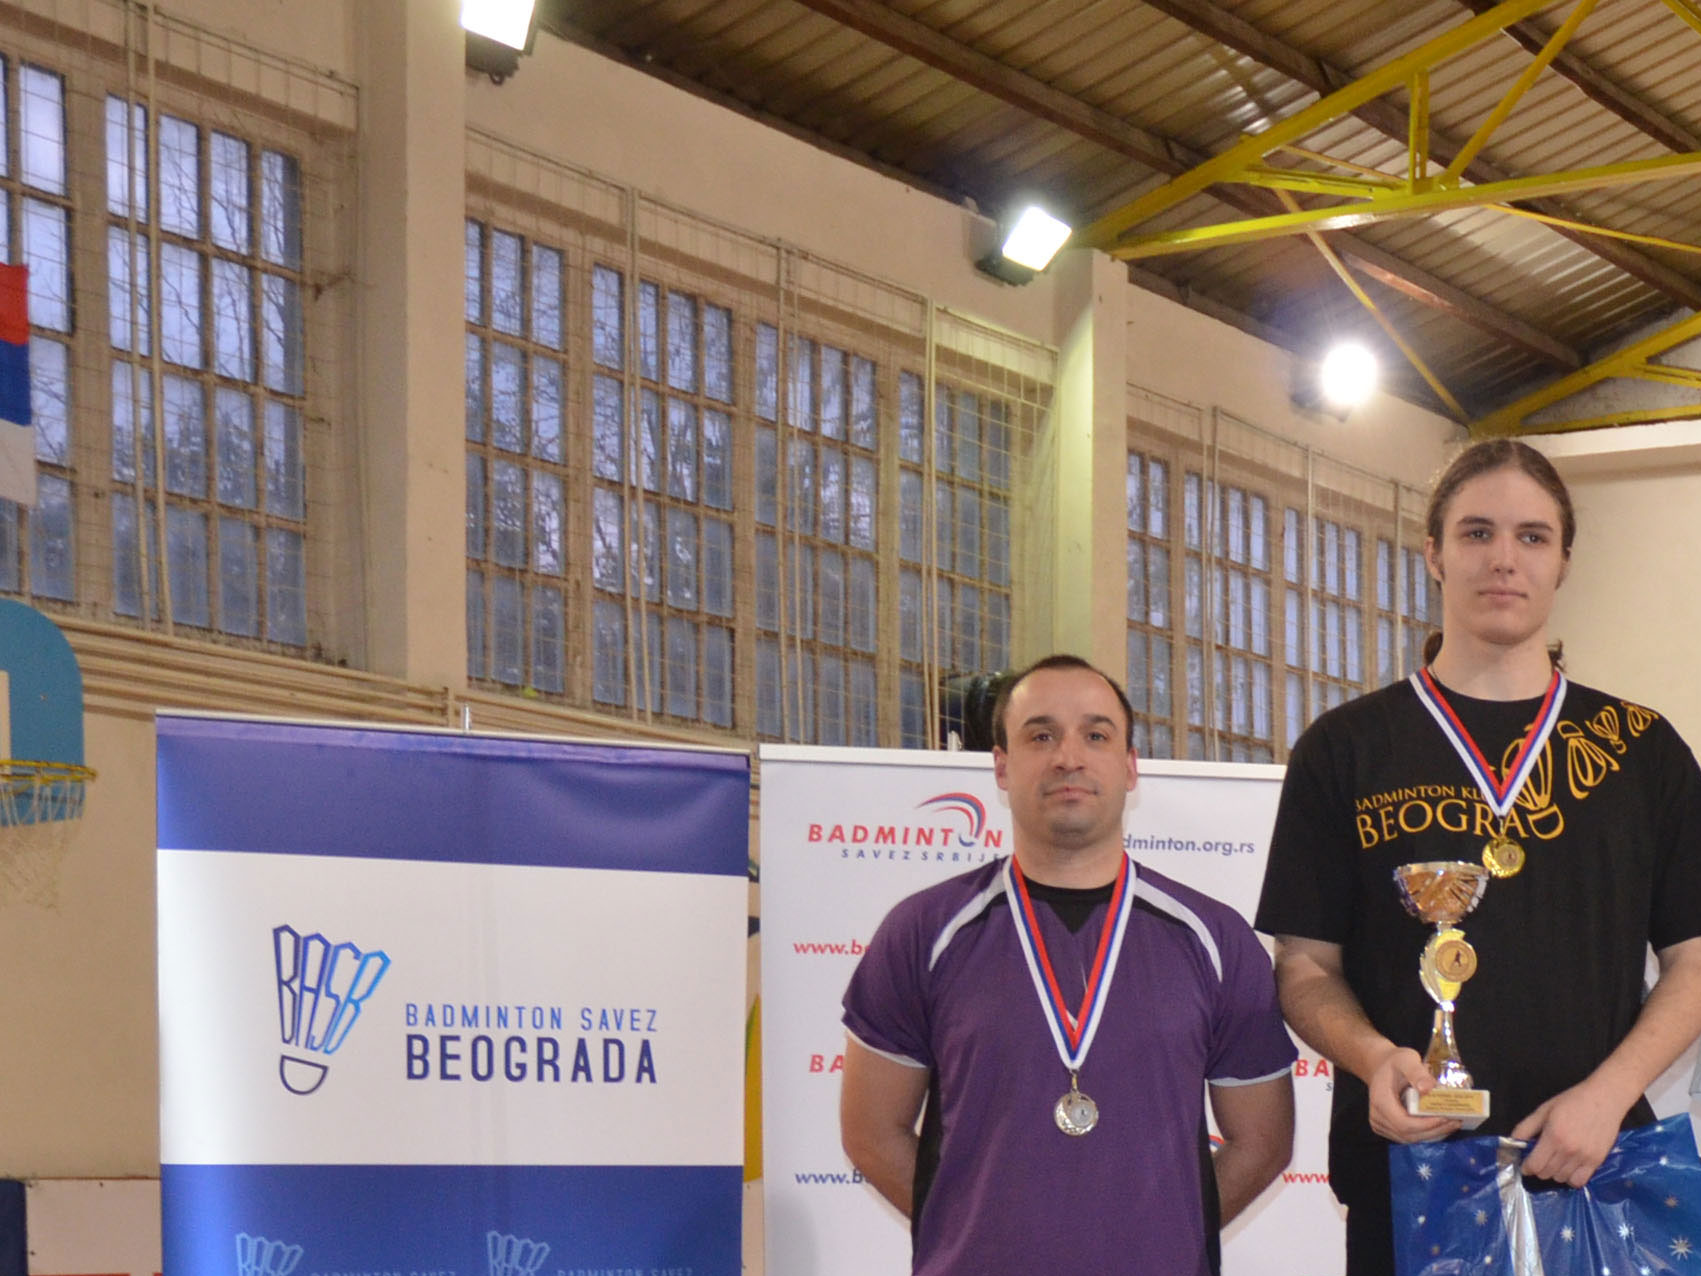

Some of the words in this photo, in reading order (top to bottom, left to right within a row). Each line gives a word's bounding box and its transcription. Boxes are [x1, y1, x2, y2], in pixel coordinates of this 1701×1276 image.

[808, 823, 1003, 848] BADMINTON
[1122, 834, 1256, 856] dminton.org.rs
[841, 848, 911, 861] SAVEZ
[406, 1002, 563, 1030] BADMINTON
[581, 1007, 658, 1032] SAVEZ
[406, 1034, 658, 1083] BEOGRADA
